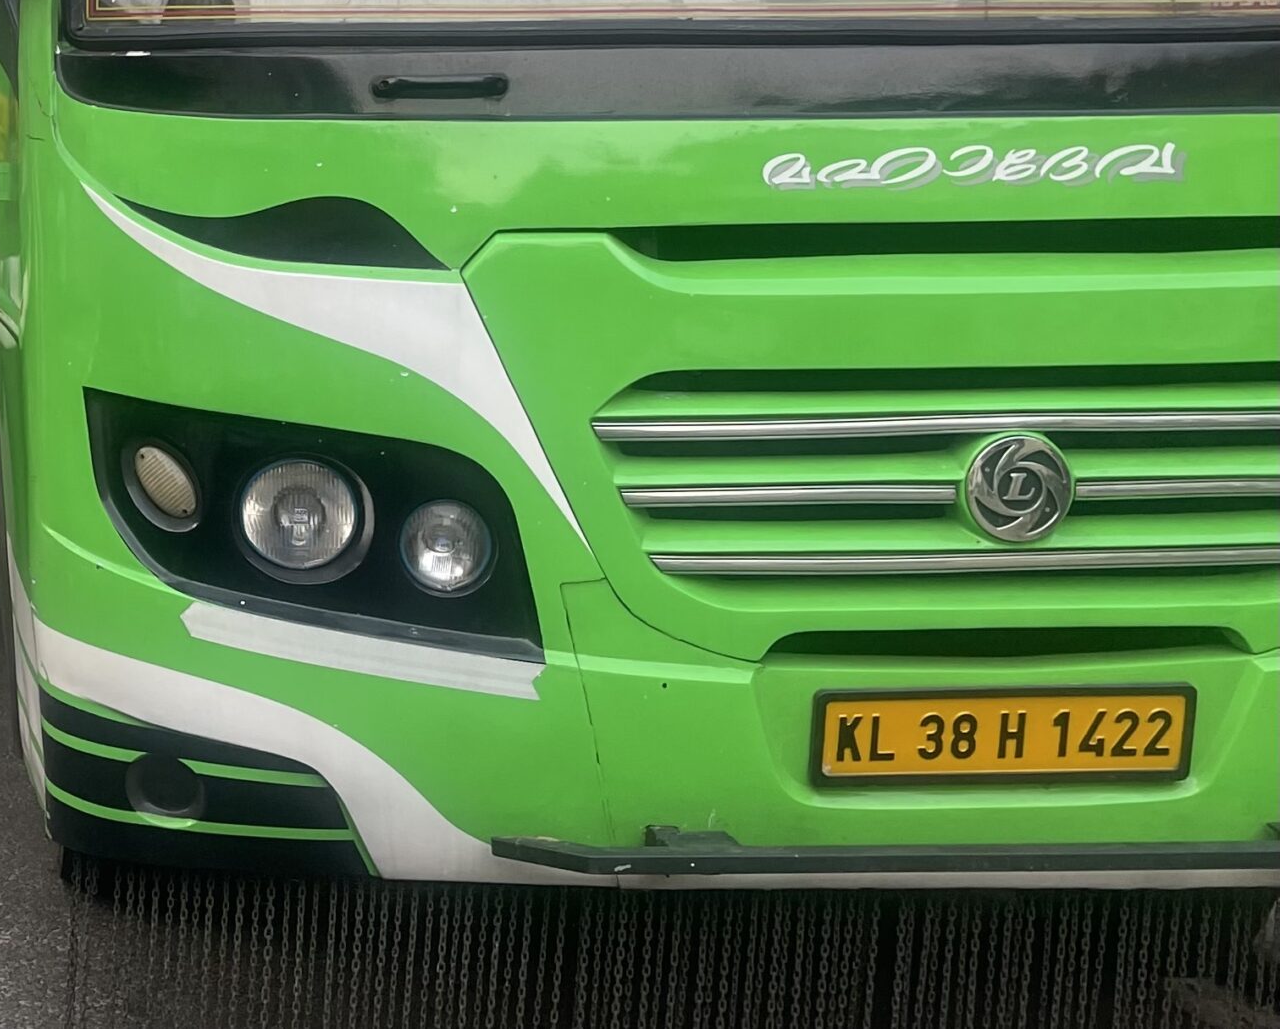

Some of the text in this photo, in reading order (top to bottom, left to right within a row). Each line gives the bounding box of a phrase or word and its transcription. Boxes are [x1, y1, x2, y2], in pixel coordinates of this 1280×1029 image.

[835, 707, 1174, 762] KL 38 H 1422
